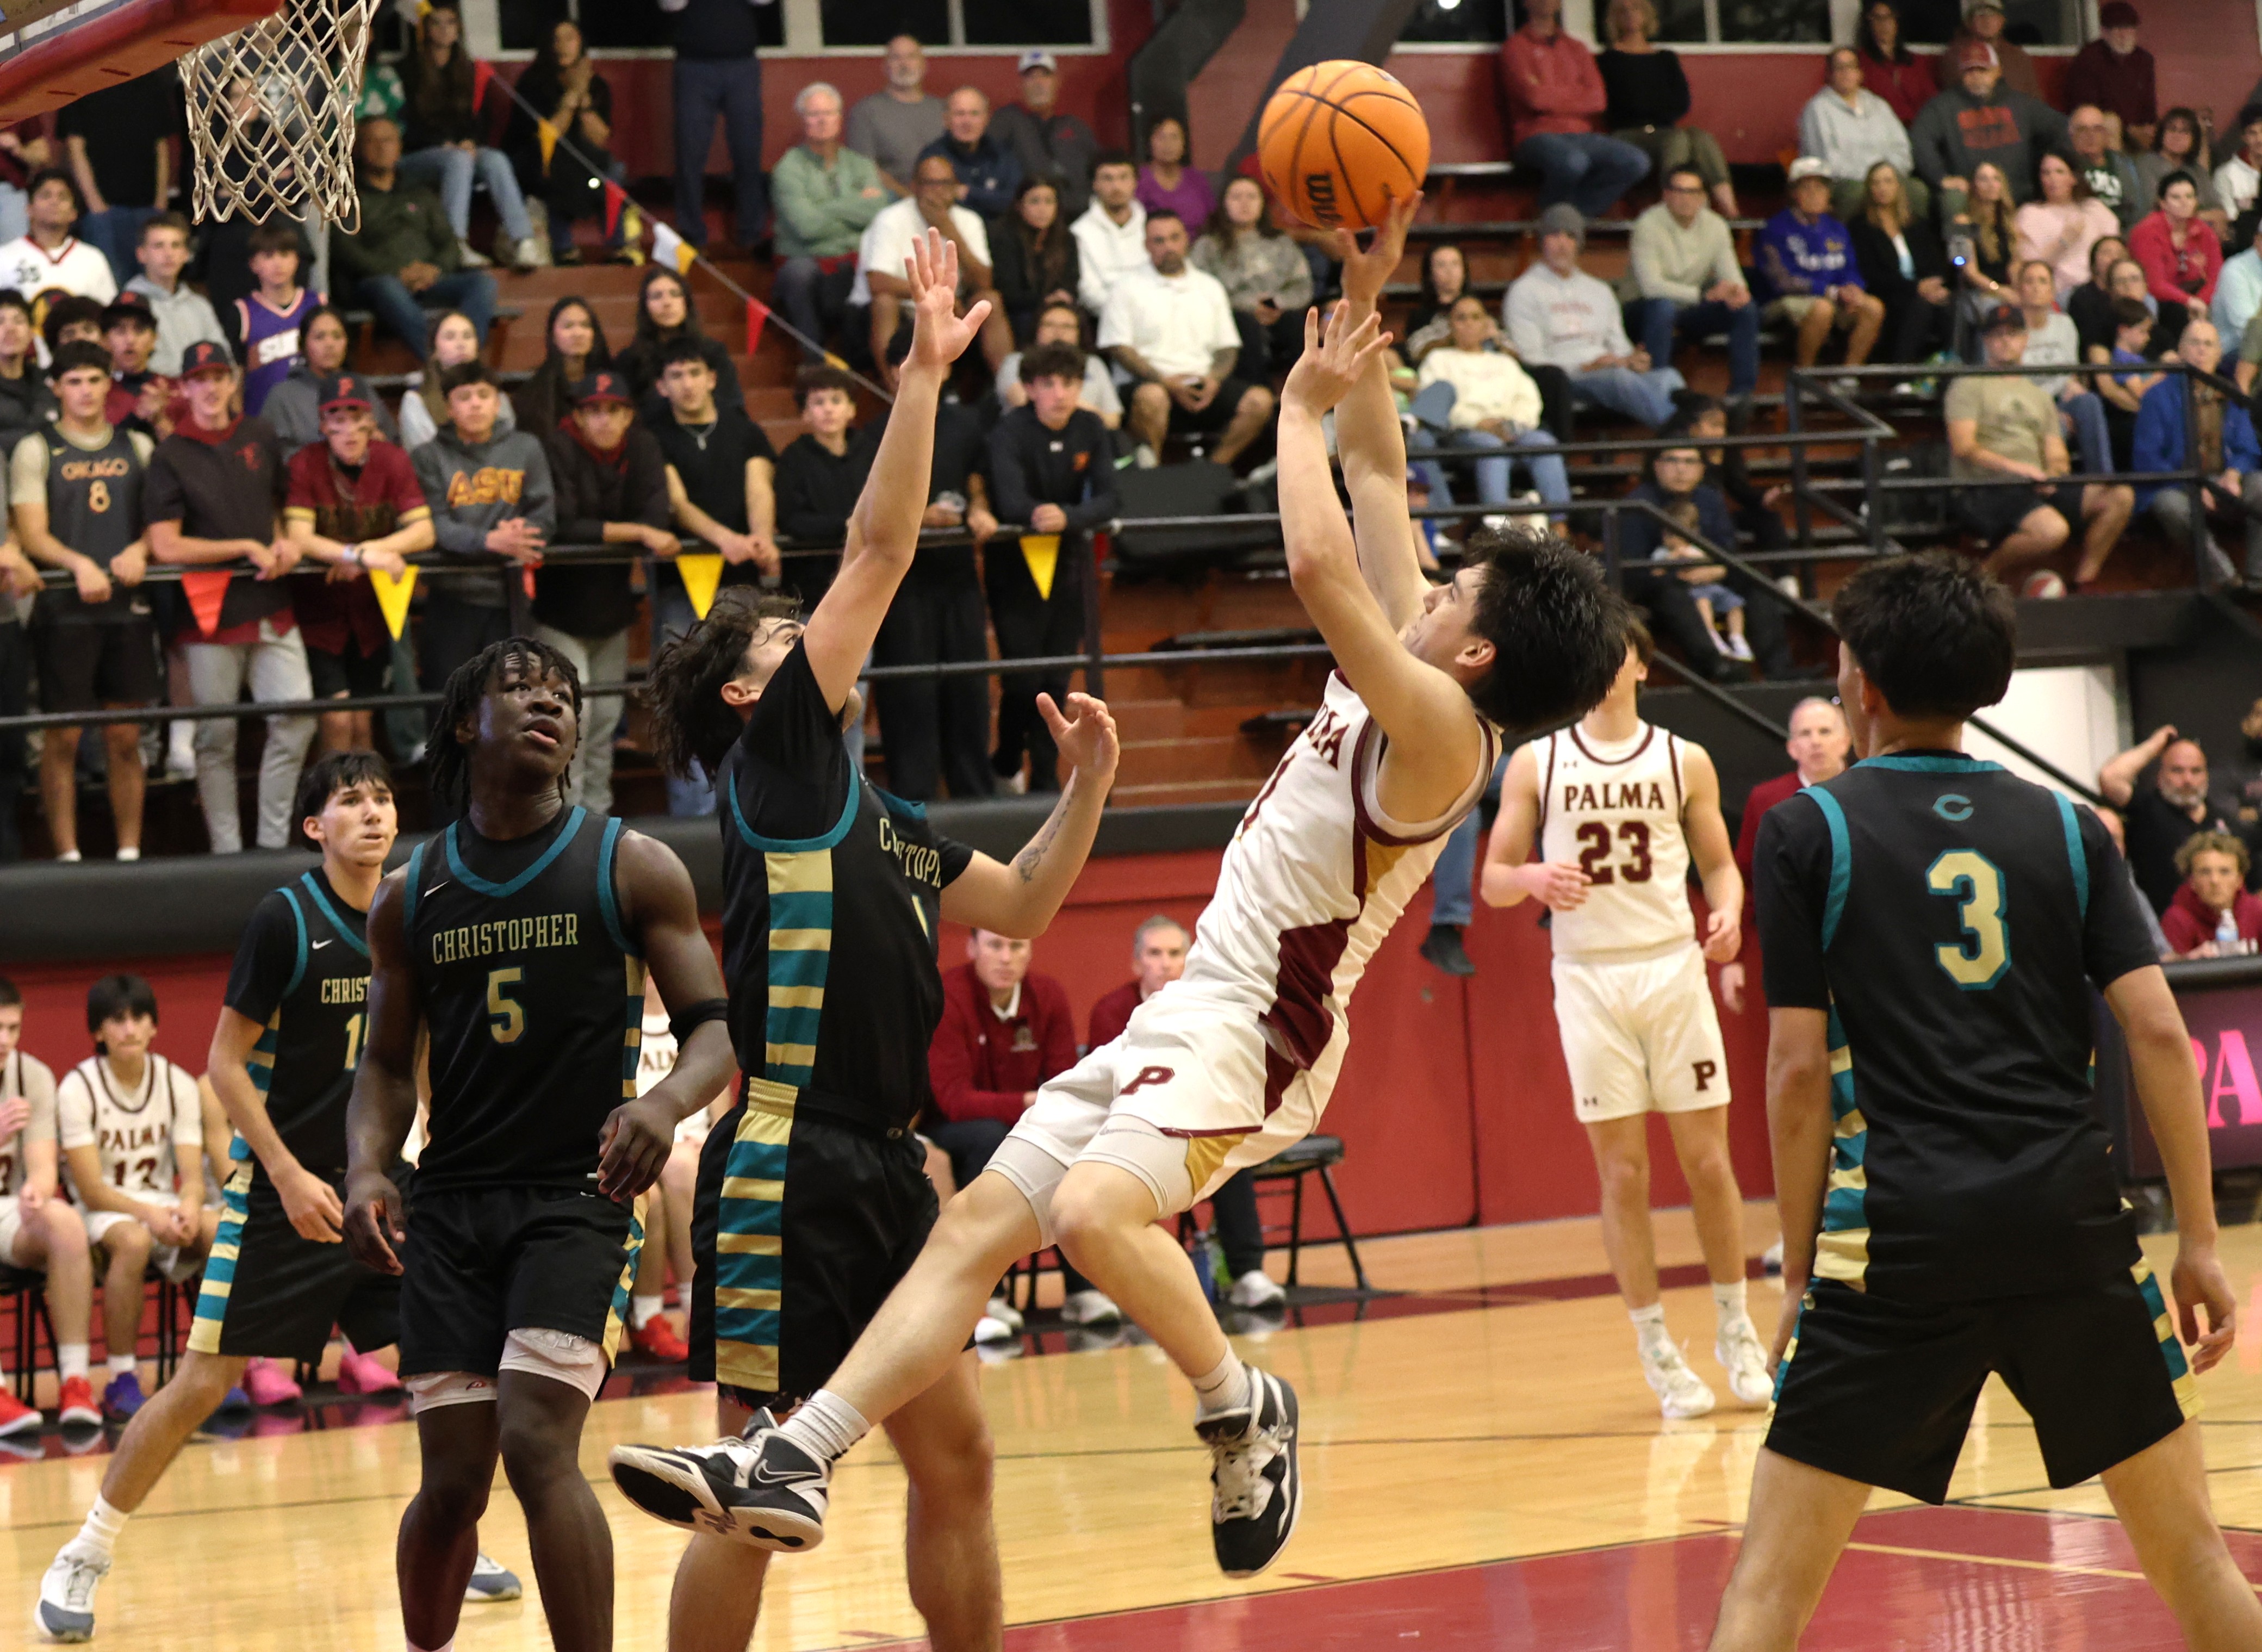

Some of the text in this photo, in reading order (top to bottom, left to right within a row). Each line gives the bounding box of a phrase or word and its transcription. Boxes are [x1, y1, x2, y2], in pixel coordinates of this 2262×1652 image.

[89, 480, 111, 513] 8
[446, 467, 525, 508] ASU
[1564, 783, 1665, 811] PALMA
[1932, 794, 1974, 821] C
[1577, 822, 1652, 884] 23
[1925, 848, 2011, 991] 3
[433, 914, 579, 964] CHRISTOPHER
[487, 966, 527, 1044] 5
[1119, 1065, 1175, 1095] P
[1692, 1061, 1716, 1091] P
